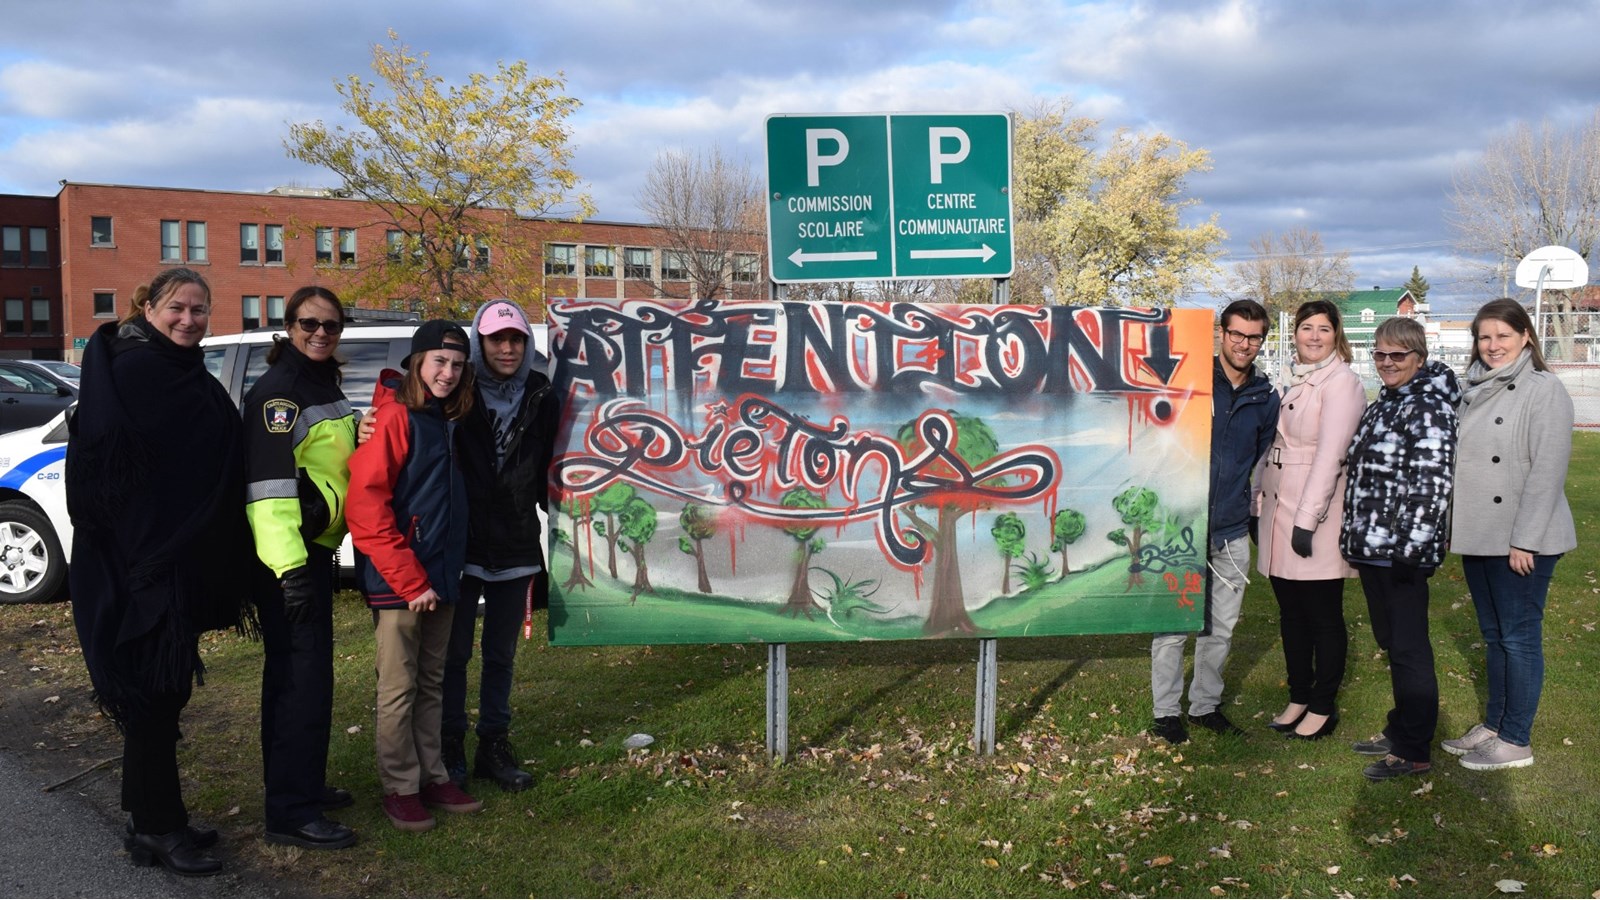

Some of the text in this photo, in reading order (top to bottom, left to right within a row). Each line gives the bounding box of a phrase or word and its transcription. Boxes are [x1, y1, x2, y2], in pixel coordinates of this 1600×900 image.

[805, 128, 850, 187] P
[928, 126, 971, 184] P
[788, 195, 873, 213] COMMISSION
[927, 193, 977, 210] CENTRE
[798, 220, 865, 239] SCOLAIRE
[899, 218, 1006, 236] COMMUNAUTAIRE
[37, 472, 60, 480] C-20
